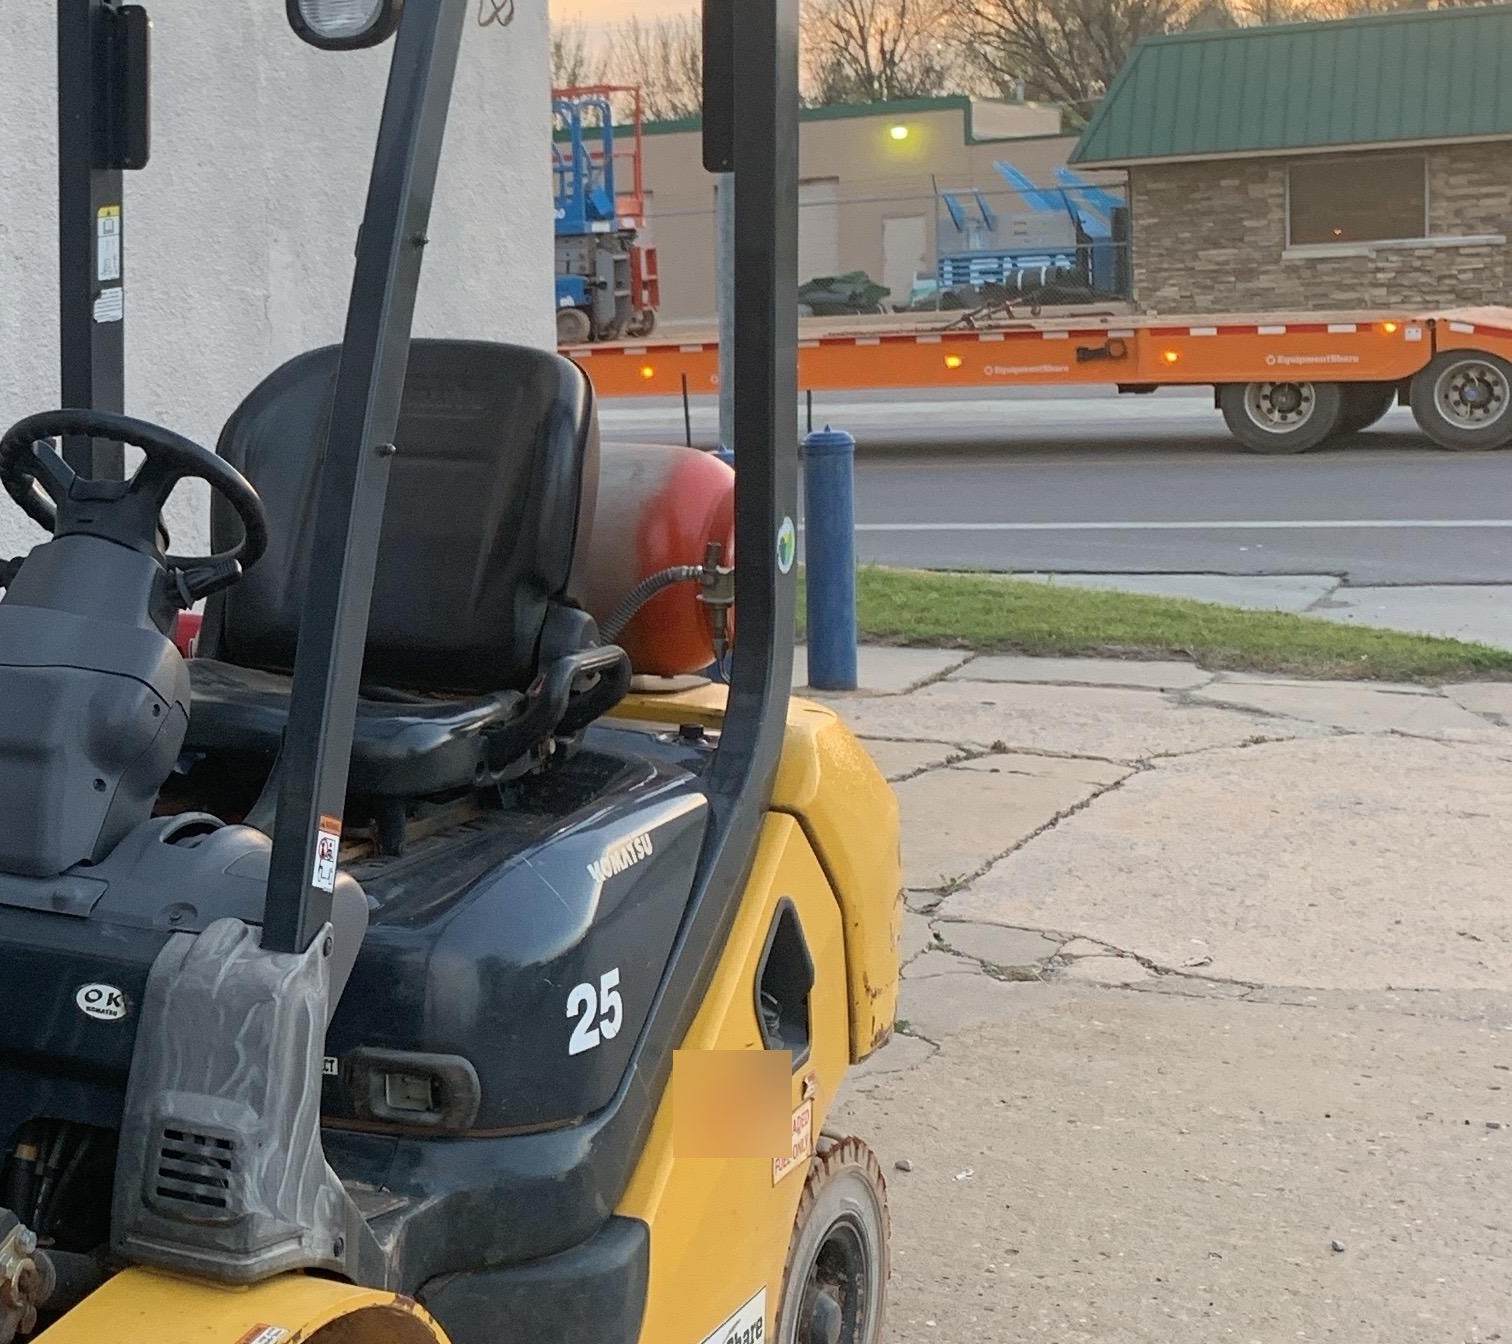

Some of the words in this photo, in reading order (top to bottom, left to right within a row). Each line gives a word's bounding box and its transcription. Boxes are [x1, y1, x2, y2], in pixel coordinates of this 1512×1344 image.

[586, 832, 653, 883] KOMATSU
[84, 989, 121, 1008] OK
[566, 967, 623, 1056] 25
